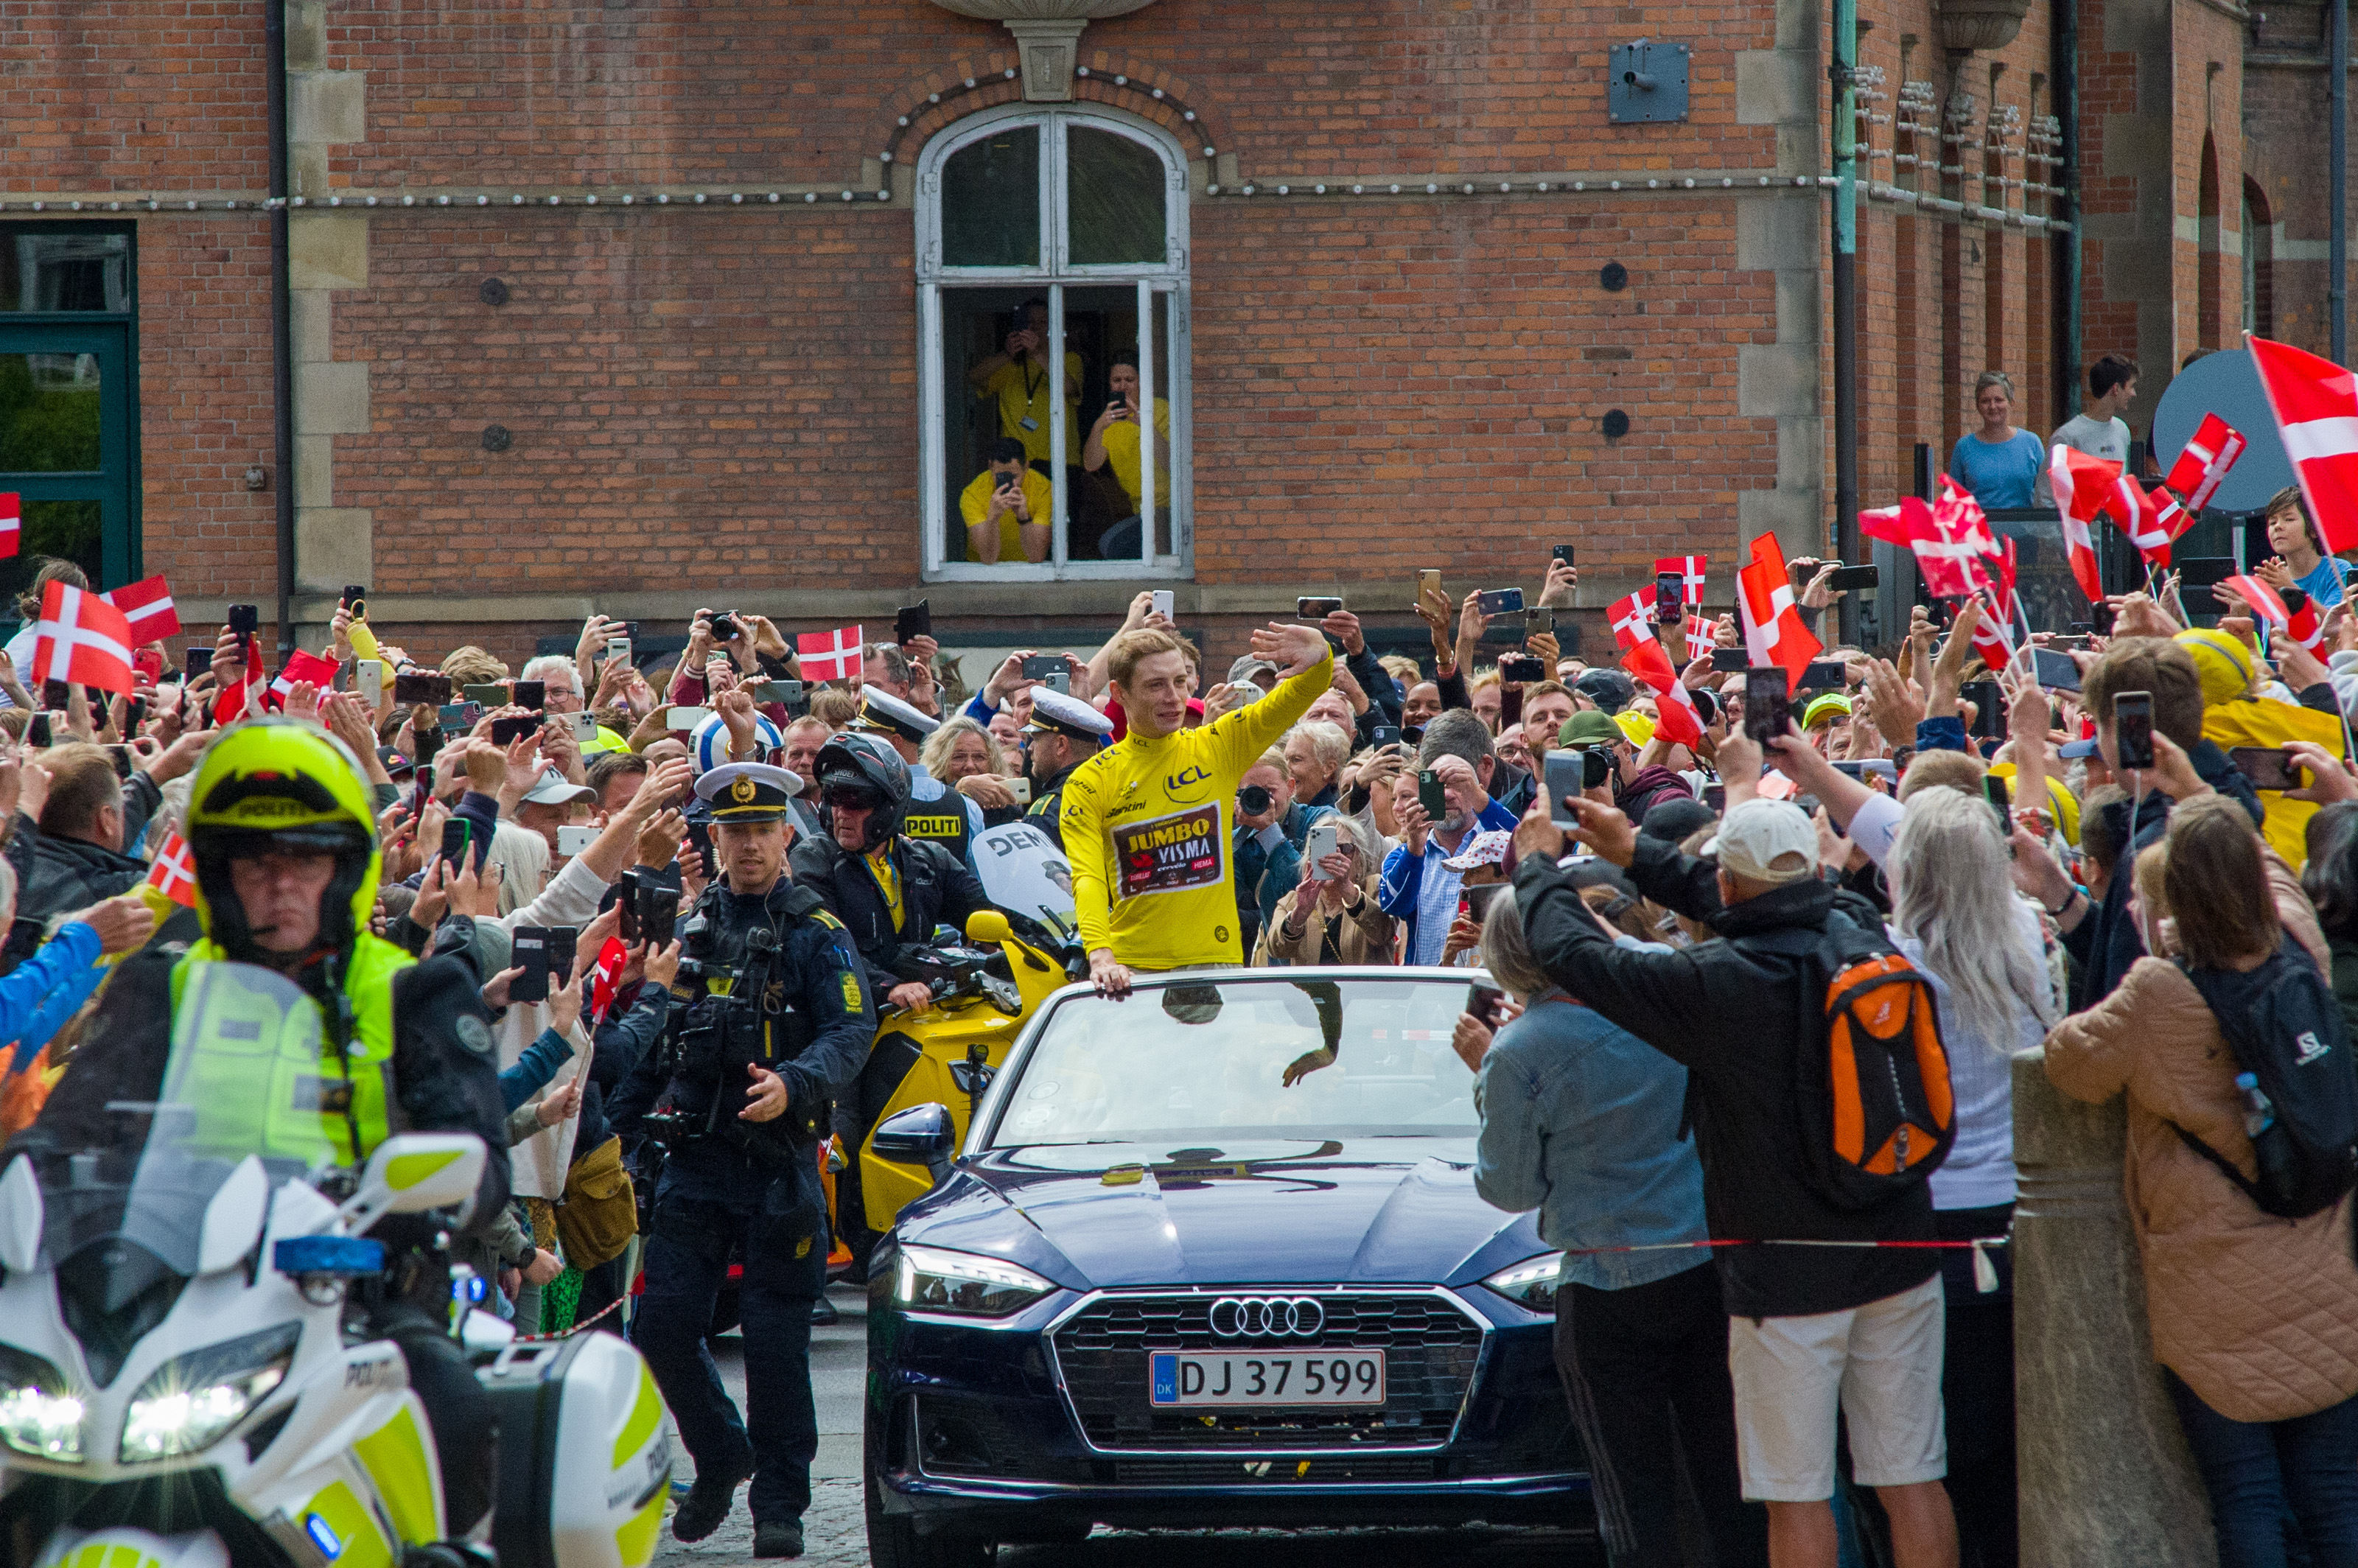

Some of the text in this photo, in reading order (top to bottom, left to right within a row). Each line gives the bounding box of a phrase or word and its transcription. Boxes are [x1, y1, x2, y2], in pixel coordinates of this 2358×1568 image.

[1133, 738, 1150, 748] LCL
[1168, 766, 1211, 790] LCL
[906, 819, 959, 833] POLITI
[1128, 818, 1210, 853] JUMBO
[1158, 837, 1211, 864] VISMA
[1194, 860, 1213, 869] HEMA
[1157, 1384, 1172, 1394] DK
